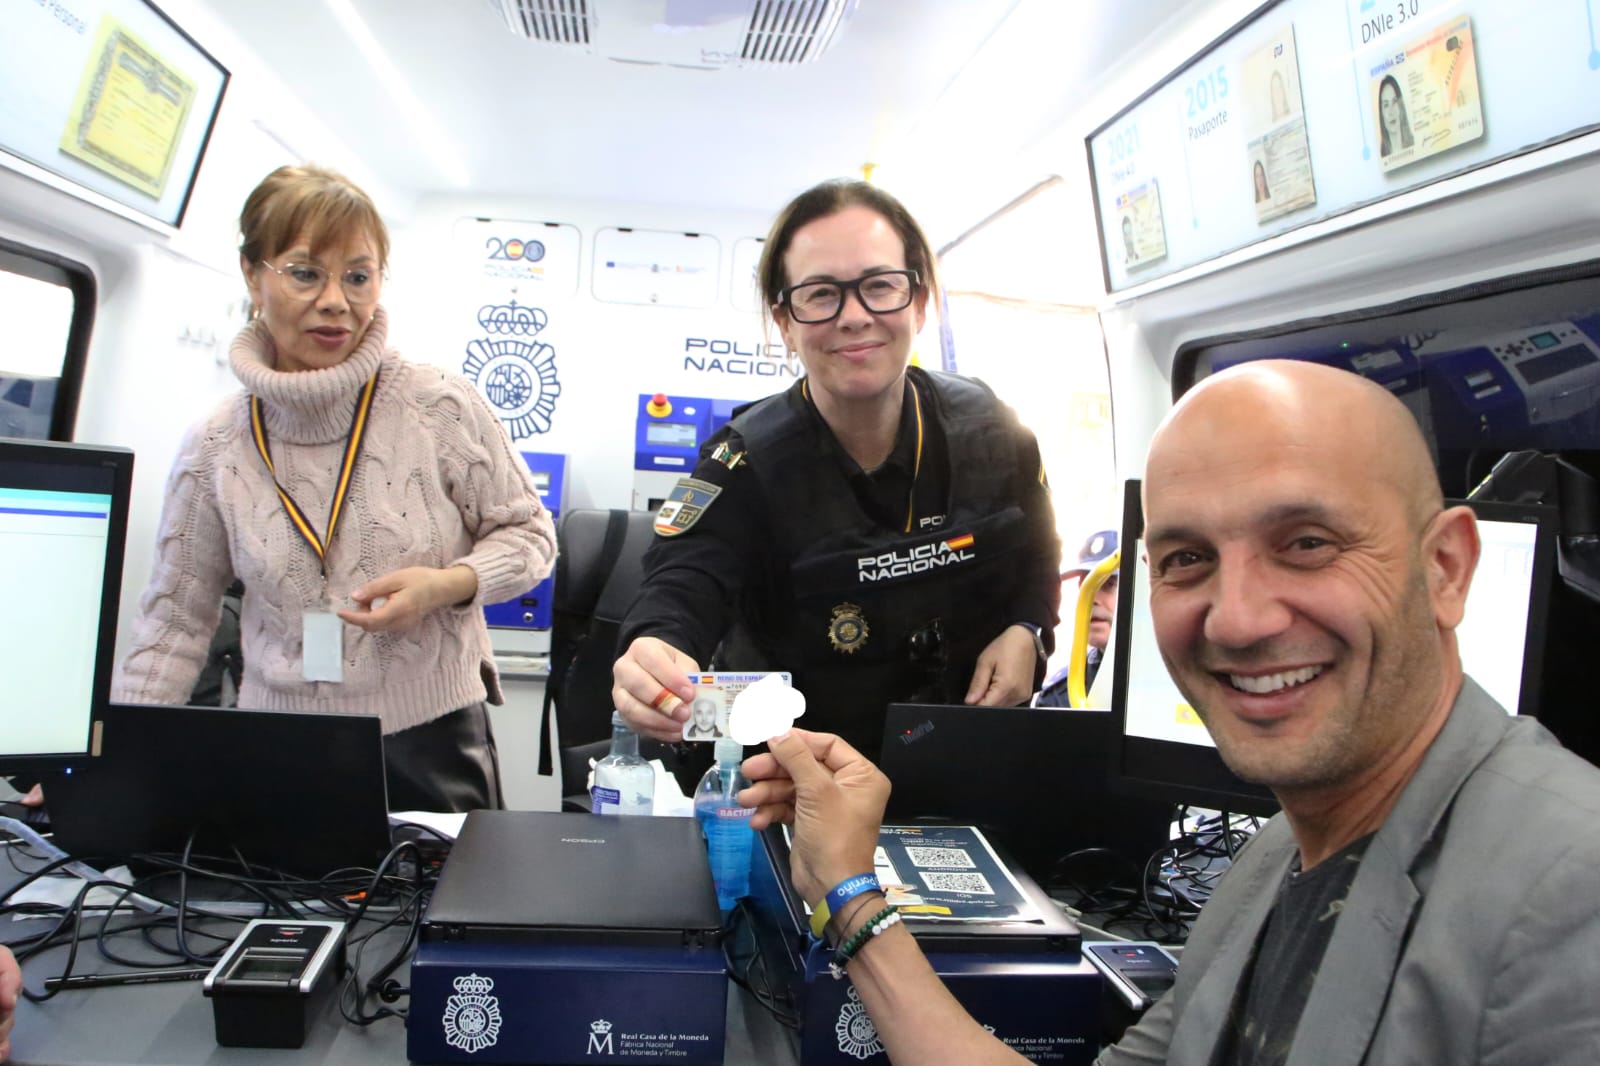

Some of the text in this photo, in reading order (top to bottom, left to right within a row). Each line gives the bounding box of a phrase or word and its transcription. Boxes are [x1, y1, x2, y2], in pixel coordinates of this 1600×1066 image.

[1361, 13, 1393, 44] DNIe
[1397, 0, 1419, 24] 3.0
[1185, 64, 1229, 118] 2015
[1188, 110, 1229, 141] Pasaporte
[1107, 122, 1140, 166] 2021
[486, 237, 546, 262] 200
[685, 338, 799, 359] POLIC
[919, 514, 946, 529] PO
[858, 541, 952, 569] POLICIA
[859, 549, 976, 583] NACIONAL
[620, 1040, 644, 1048] Fábrica
[658, 1033, 668, 1041] de
[669, 1033, 677, 1041] la
[664, 1049, 687, 1057] Timbre
